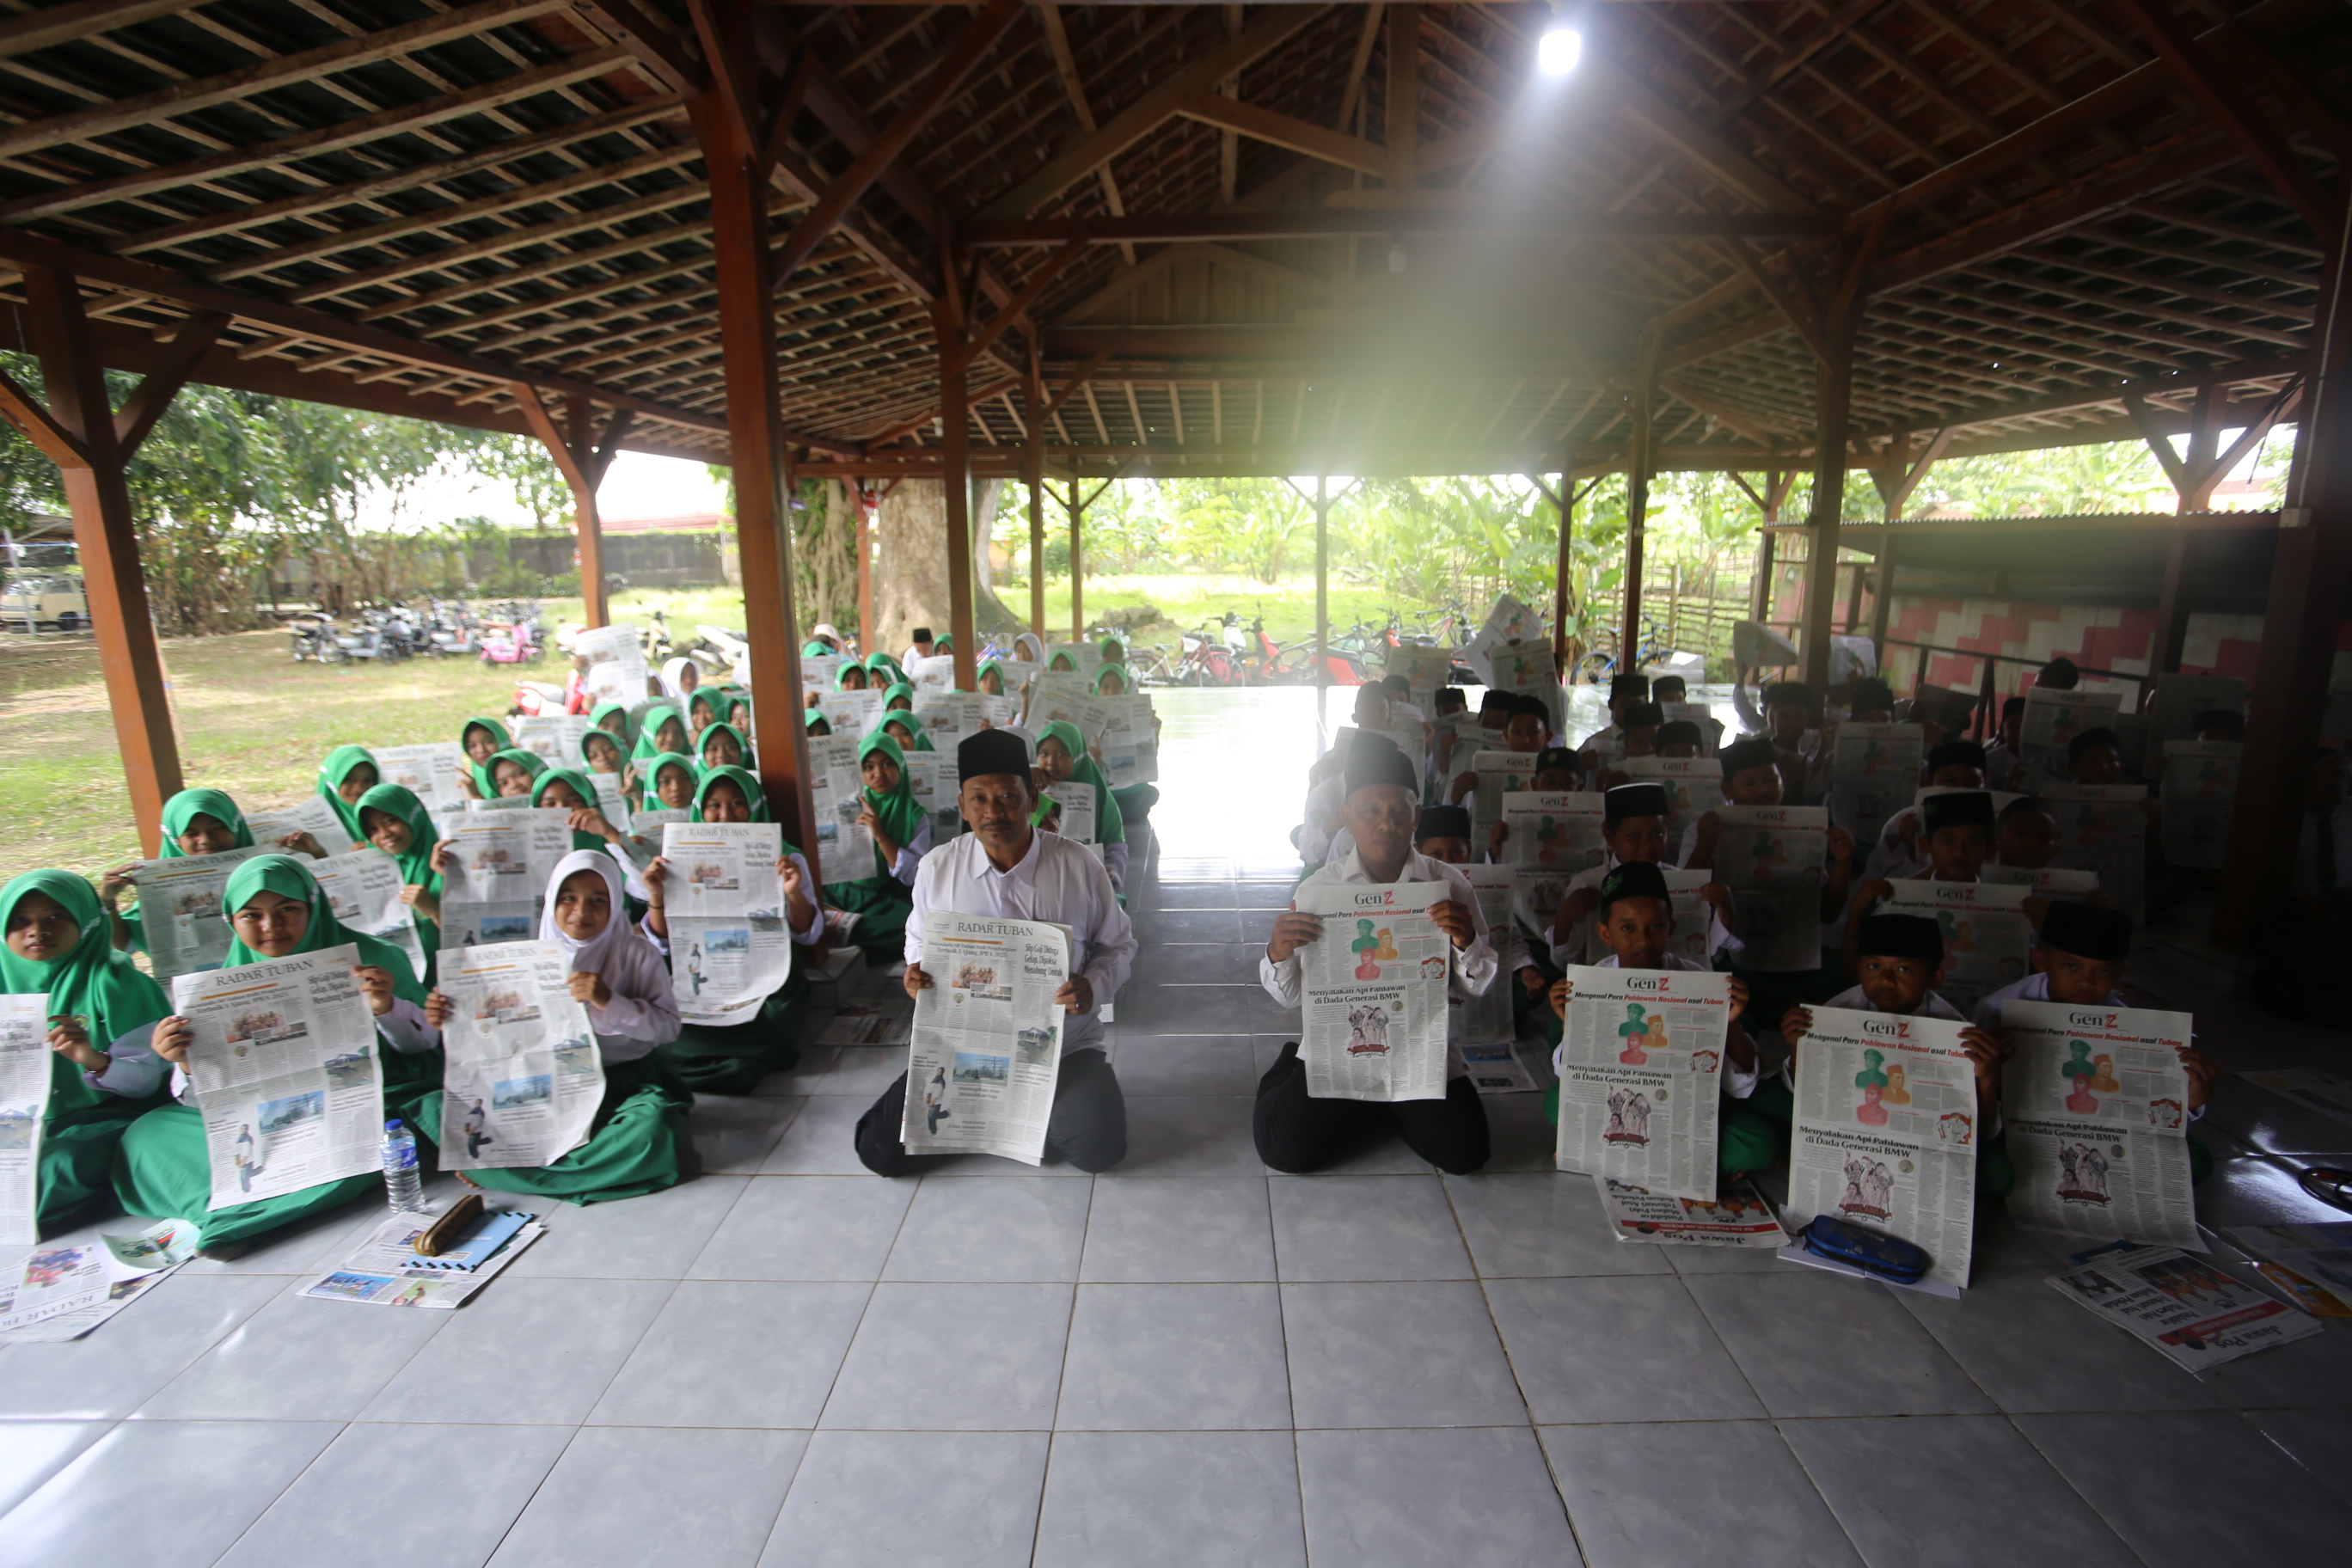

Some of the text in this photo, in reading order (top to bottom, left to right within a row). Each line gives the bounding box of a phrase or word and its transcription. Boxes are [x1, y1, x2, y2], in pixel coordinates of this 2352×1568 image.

[689, 829, 750, 837] RADAR TUBAN
[1385, 908, 1412, 916] Nasional
[958, 922, 1033, 937] RADAR TUBAN
[1025, 944, 1059, 956] Slip Gaji Diduga
[1038, 956, 1057, 965] Dipaksa
[215, 959, 315, 987] RADAR TUBAN
[1024, 965, 1063, 977] Menabung Umrah
[1308, 989, 1354, 998] Menyalakan
[1324, 995, 1344, 1004] Dada
[1344, 994, 1379, 1003] Generasi
[1379, 992, 1401, 1001] BMW
[1575, 991, 1608, 1001] Mengenal
[1624, 994, 1657, 1003] Pahlawan
[1657, 995, 1687, 1004] Nasional
[1704, 997, 1724, 1006] Tuban
[196, 1004, 224, 1015] Terbaik
[230, 999, 251, 1010] Ajang
[2048, 1028, 2066, 1037] Para
[2066, 1030, 2104, 1040] Pahlawan
[2104, 1033, 2140, 1043] Nasional
[2158, 1038, 2183, 1047] Tuban
[1807, 1032, 1969, 1059] Mengenal Para Pahlawan Nasional asal Tuban
[1566, 1064, 1616, 1075] Menyalakan
[1582, 1074, 1603, 1082] Dada
[1604, 1075, 1641, 1086] Generasi
[1642, 1078, 1666, 1087] BMW
[2018, 1125, 2122, 1143] di Dada Generasi BMW
[2084, 1124, 2128, 1135] Pahlawan
[1798, 1125, 1854, 1141] Menyalakan
[1855, 1135, 1871, 1144] Api
[1872, 1136, 1920, 1151] Pahlawan
[1805, 1135, 1912, 1158] di Dada Generasi BMW
[1663, 1233, 1746, 1245] Jawa Pos
[27, 1295, 94, 1320] RADAR
[2120, 1305, 2138, 1315] Asal
[2137, 1308, 2158, 1322] Polri
[2214, 1325, 2284, 1351] Jawa Pos
